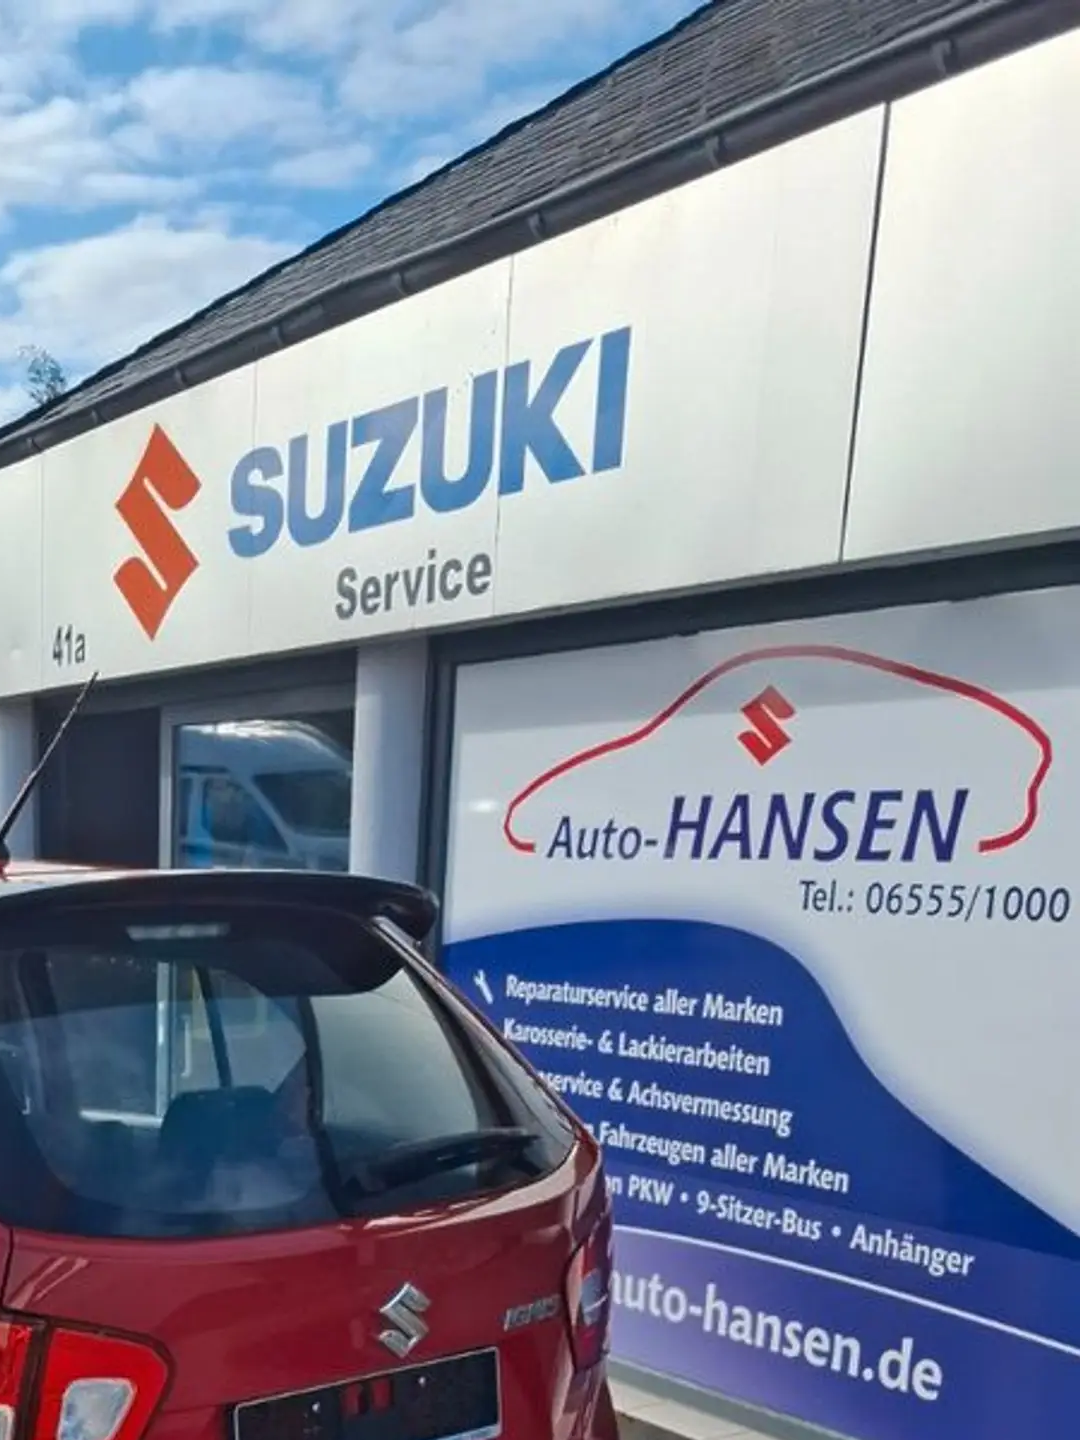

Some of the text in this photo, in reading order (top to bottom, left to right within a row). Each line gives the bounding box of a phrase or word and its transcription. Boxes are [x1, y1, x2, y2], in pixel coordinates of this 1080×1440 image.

[227, 326, 632, 559] SUZUKI
[335, 549, 492, 621] Service
[52, 623, 85, 668] 41a
[547, 788, 969, 863] Auto-HANSEN
[800, 880, 1070, 922] Tel.: 06555/1000
[506, 974, 783, 1027] Reparaturservice aller Marken
[503, 1017, 770, 1077] Karosserie- & Lackierarbeiten
[607, 1078, 623, 1102] &
[627, 1080, 794, 1137] Achsvermessung
[599, 1121, 850, 1194] Fahrzeugen aller Marken
[628, 1174, 675, 1206] PKW
[696, 1190, 823, 1241] 9-Sitzer-Bus
[849, 1223, 976, 1277] Anhänger
